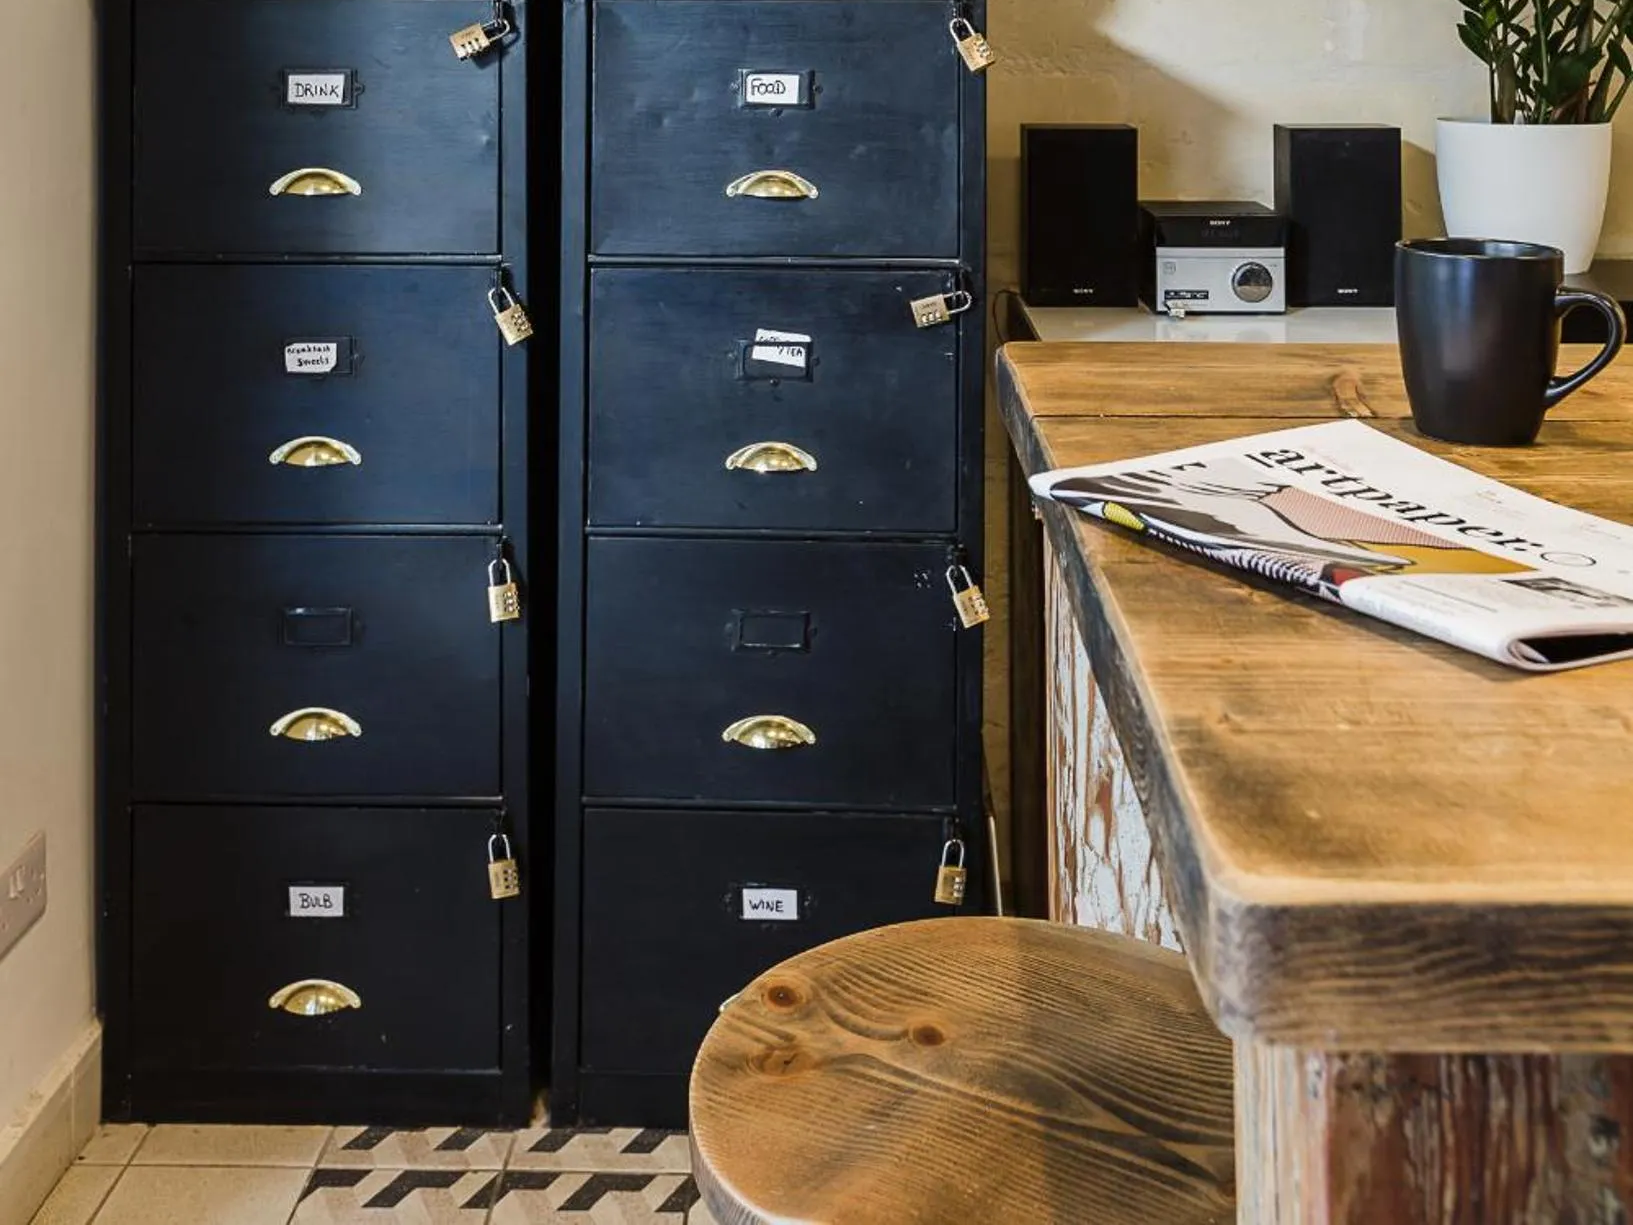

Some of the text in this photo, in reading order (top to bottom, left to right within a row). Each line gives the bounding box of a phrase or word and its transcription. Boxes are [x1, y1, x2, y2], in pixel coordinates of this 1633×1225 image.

[294, 82, 339, 97] DRINK
[751, 78, 786, 96] FOOD
[299, 893, 333, 909] BULB
[749, 899, 784, 913] WINE
